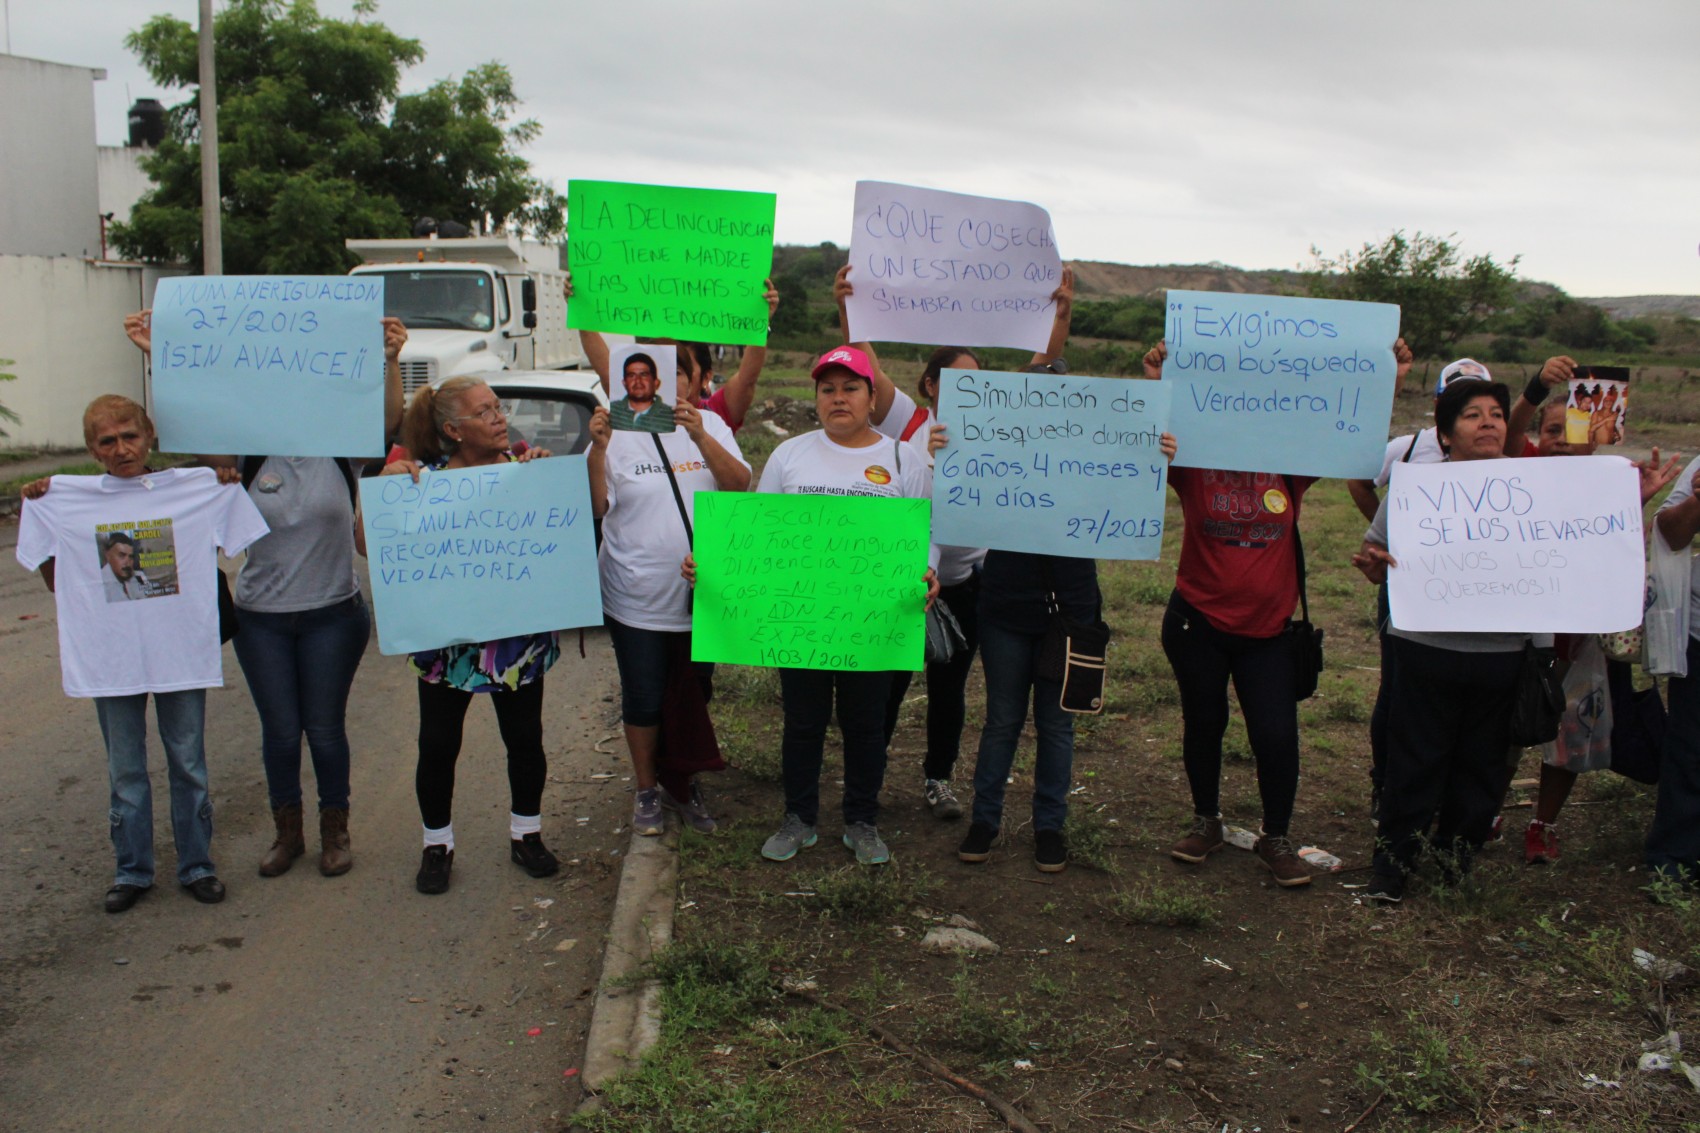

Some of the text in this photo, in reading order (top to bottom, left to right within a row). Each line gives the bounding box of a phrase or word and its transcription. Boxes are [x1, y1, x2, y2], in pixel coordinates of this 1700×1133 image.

[579, 194, 771, 238] LA DELINCUENCIA
[957, 217, 1055, 251] COSECH
[573, 239, 751, 269] NO TIENE MADRE
[868, 254, 1055, 284] UN ESTADO QUE
[168, 280, 382, 308] NUM AVERIGUACION
[588, 271, 629, 294] LAS
[639, 274, 731, 298] VICTIMAS
[594, 299, 654, 326] HASTA
[872, 288, 963, 312] SIEMBRA
[184, 302, 319, 336] 27/2013
[1238, 345, 1376, 382] búsqueda
[956, 374, 1146, 413] Simulación de
[962, 414, 1084, 448] búsqueda
[941, 450, 1163, 492] 6 años, 4 meses y
[381, 472, 500, 509] 03/2017
[826, 486, 846, 496] HASTA
[947, 486, 1055, 508] 24 días
[371, 507, 579, 540] SIMULACION EN
[1066, 509, 1162, 544] 27/2013
[1419, 517, 1454, 547] SE
[1464, 517, 1510, 542] LOS
[380, 538, 558, 565] RECOMENDACION
[848, 555, 883, 577] De
[1516, 549, 1569, 569] LOS
[381, 561, 532, 586] VIOLATORIA
[760, 647, 859, 669] 1403/2016
